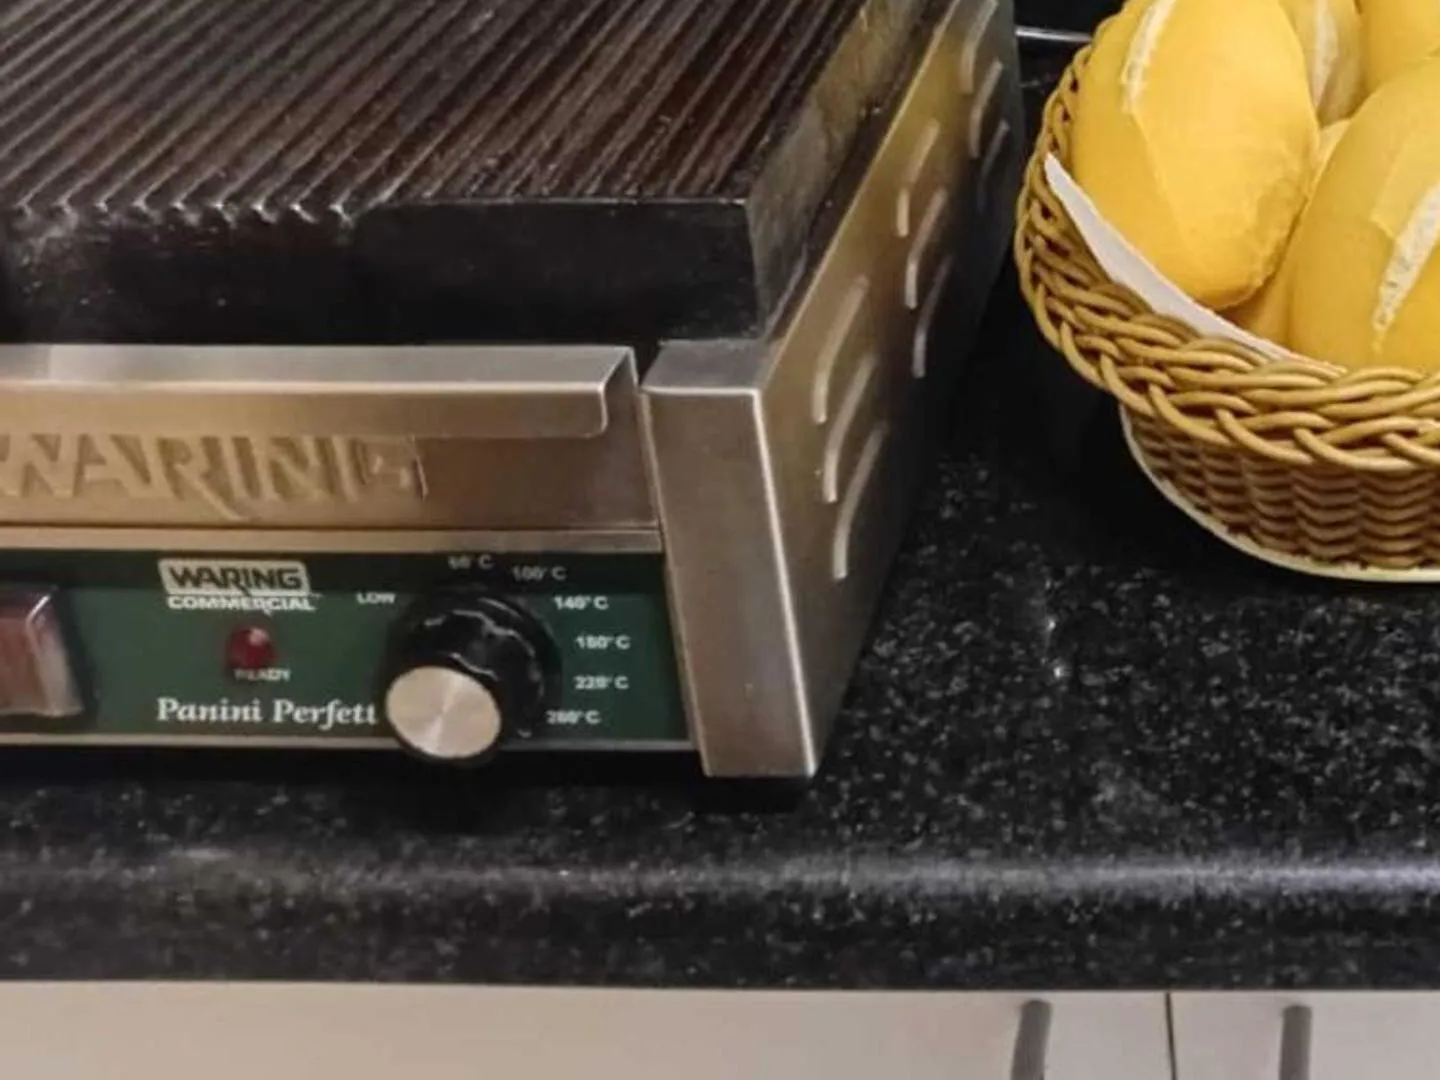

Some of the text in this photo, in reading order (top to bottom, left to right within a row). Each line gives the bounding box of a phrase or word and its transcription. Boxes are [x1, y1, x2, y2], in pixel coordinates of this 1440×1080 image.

[167, 566, 302, 594] WARING
[356, 591, 396, 605] LOW
[157, 696, 263, 722] Panini
